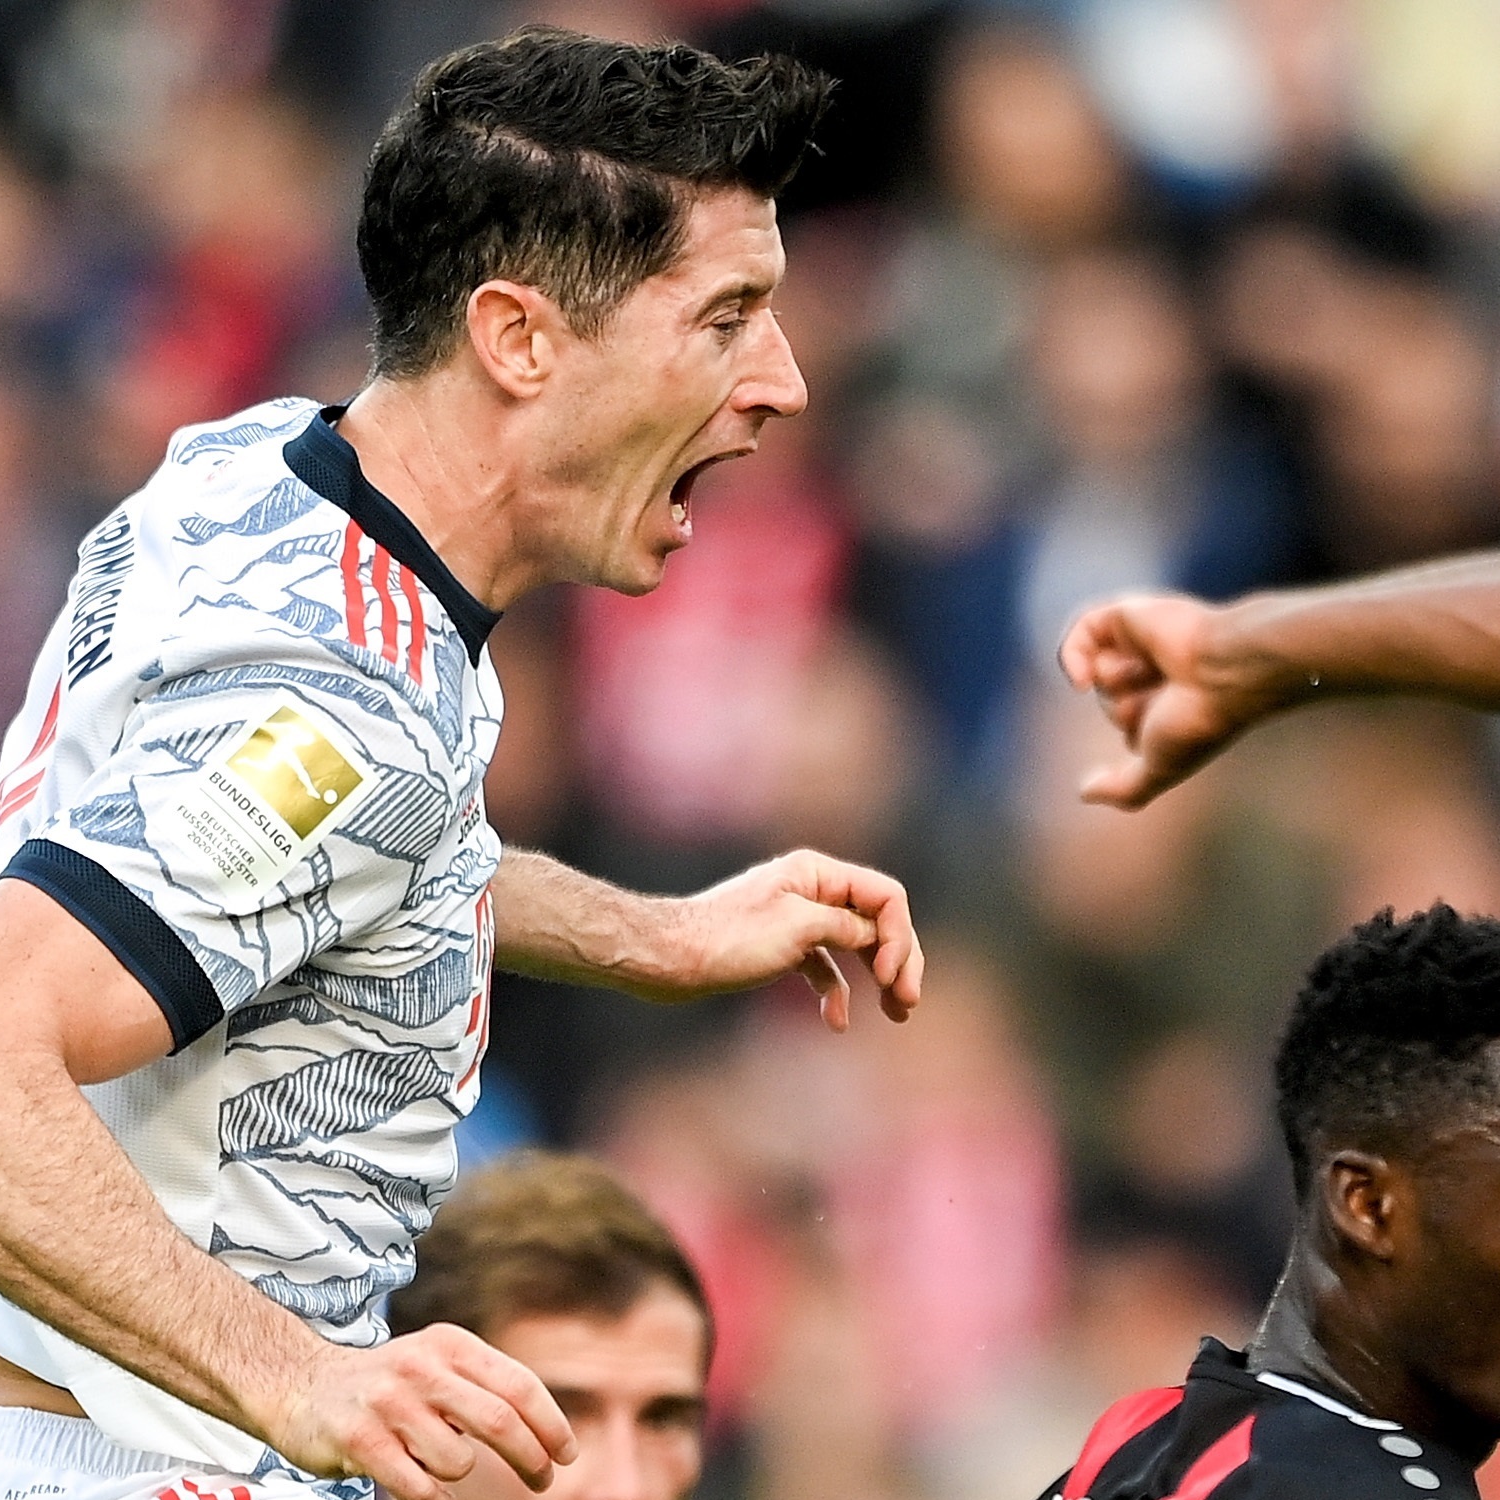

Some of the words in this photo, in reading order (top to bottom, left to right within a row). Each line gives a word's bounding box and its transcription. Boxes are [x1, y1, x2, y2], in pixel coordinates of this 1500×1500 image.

[176, 804, 259, 888] FUSSBALLMEISTER
[200, 810, 256, 866] DEUTSCHER
[208, 771, 293, 858] BUNDESLIGA
[187, 831, 236, 879] 2020/2021
